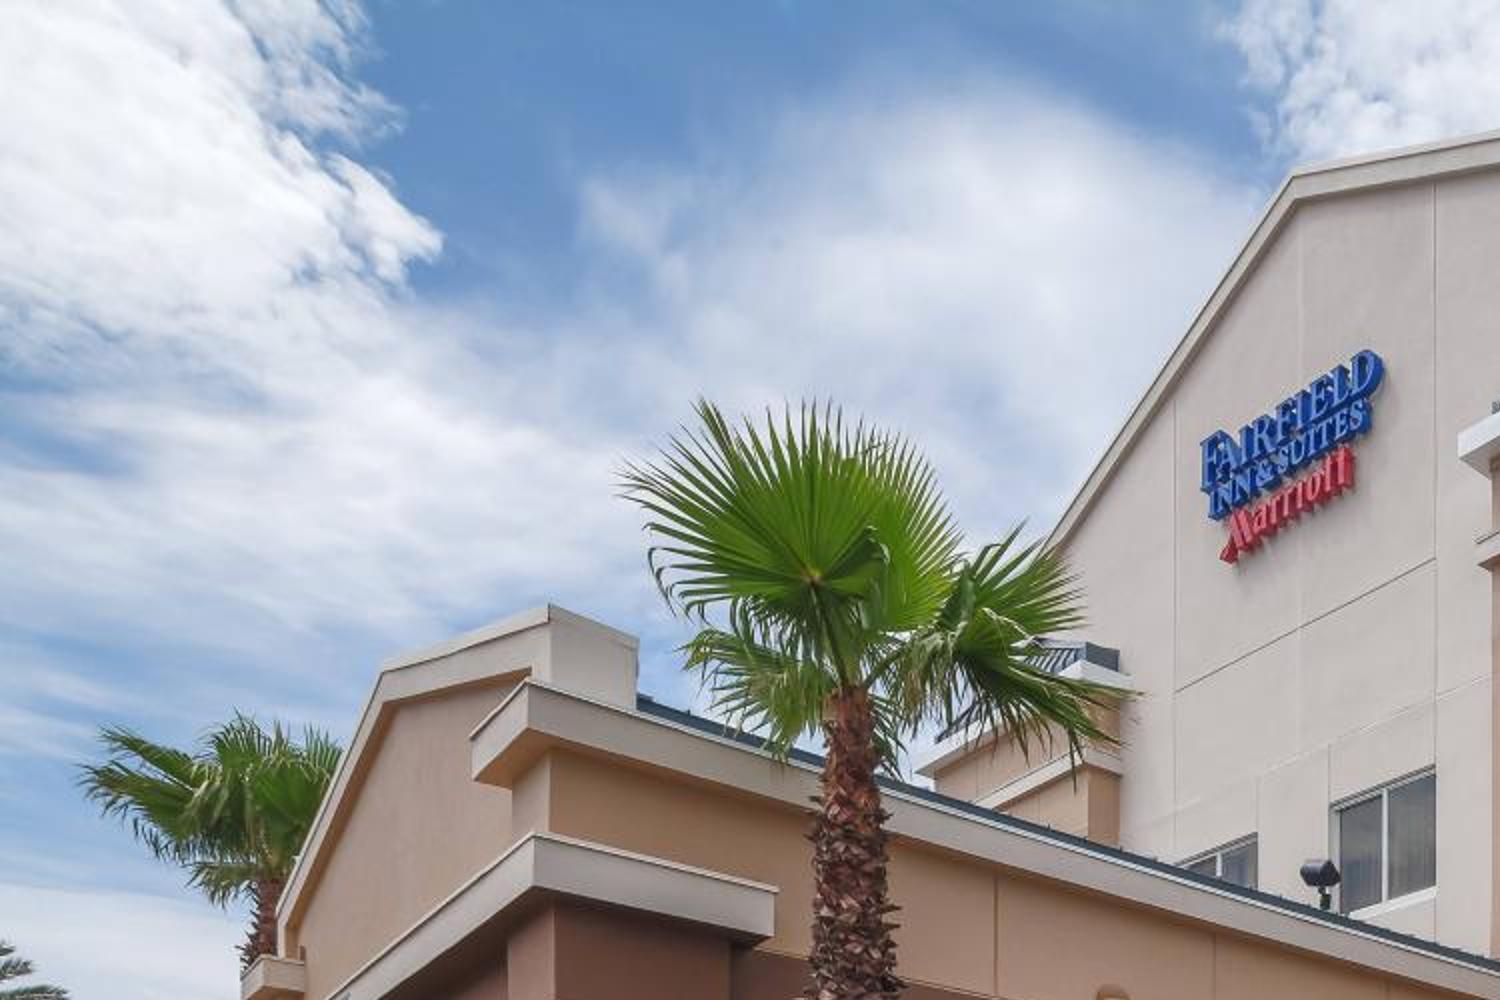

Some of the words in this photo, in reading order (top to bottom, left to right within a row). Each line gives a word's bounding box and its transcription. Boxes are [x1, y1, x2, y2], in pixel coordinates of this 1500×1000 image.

[1200, 349, 1384, 495] FAIRFIELD
[1275, 398, 1372, 483] SUITES
[1219, 443, 1356, 564] Marriott
